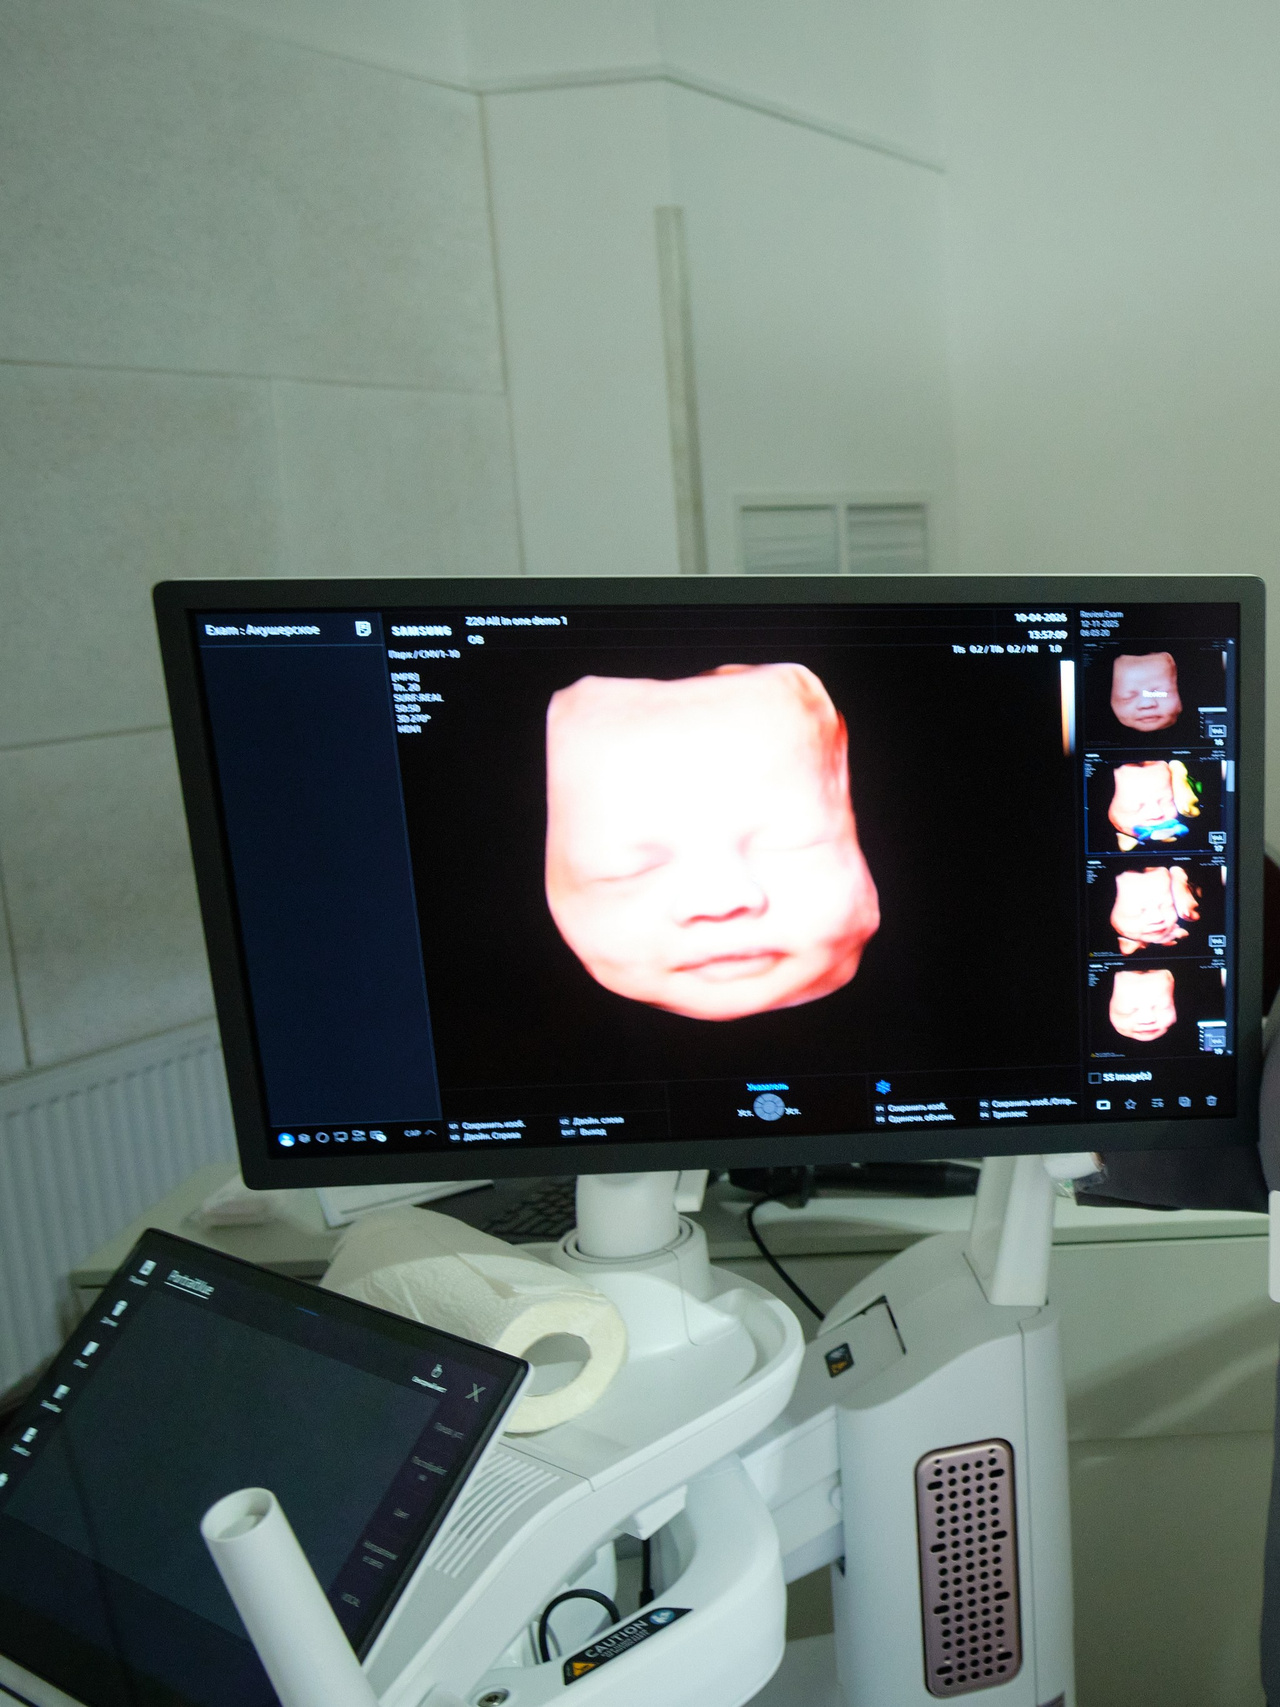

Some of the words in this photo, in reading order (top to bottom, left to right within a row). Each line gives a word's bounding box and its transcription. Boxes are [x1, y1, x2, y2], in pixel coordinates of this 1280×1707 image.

[531, 616, 561, 626] demo
[205, 624, 240, 636] Exam
[245, 624, 321, 638] Акушерское
[391, 625, 453, 637] SAMSUNG
[584, 1619, 649, 1658] CAUTION
